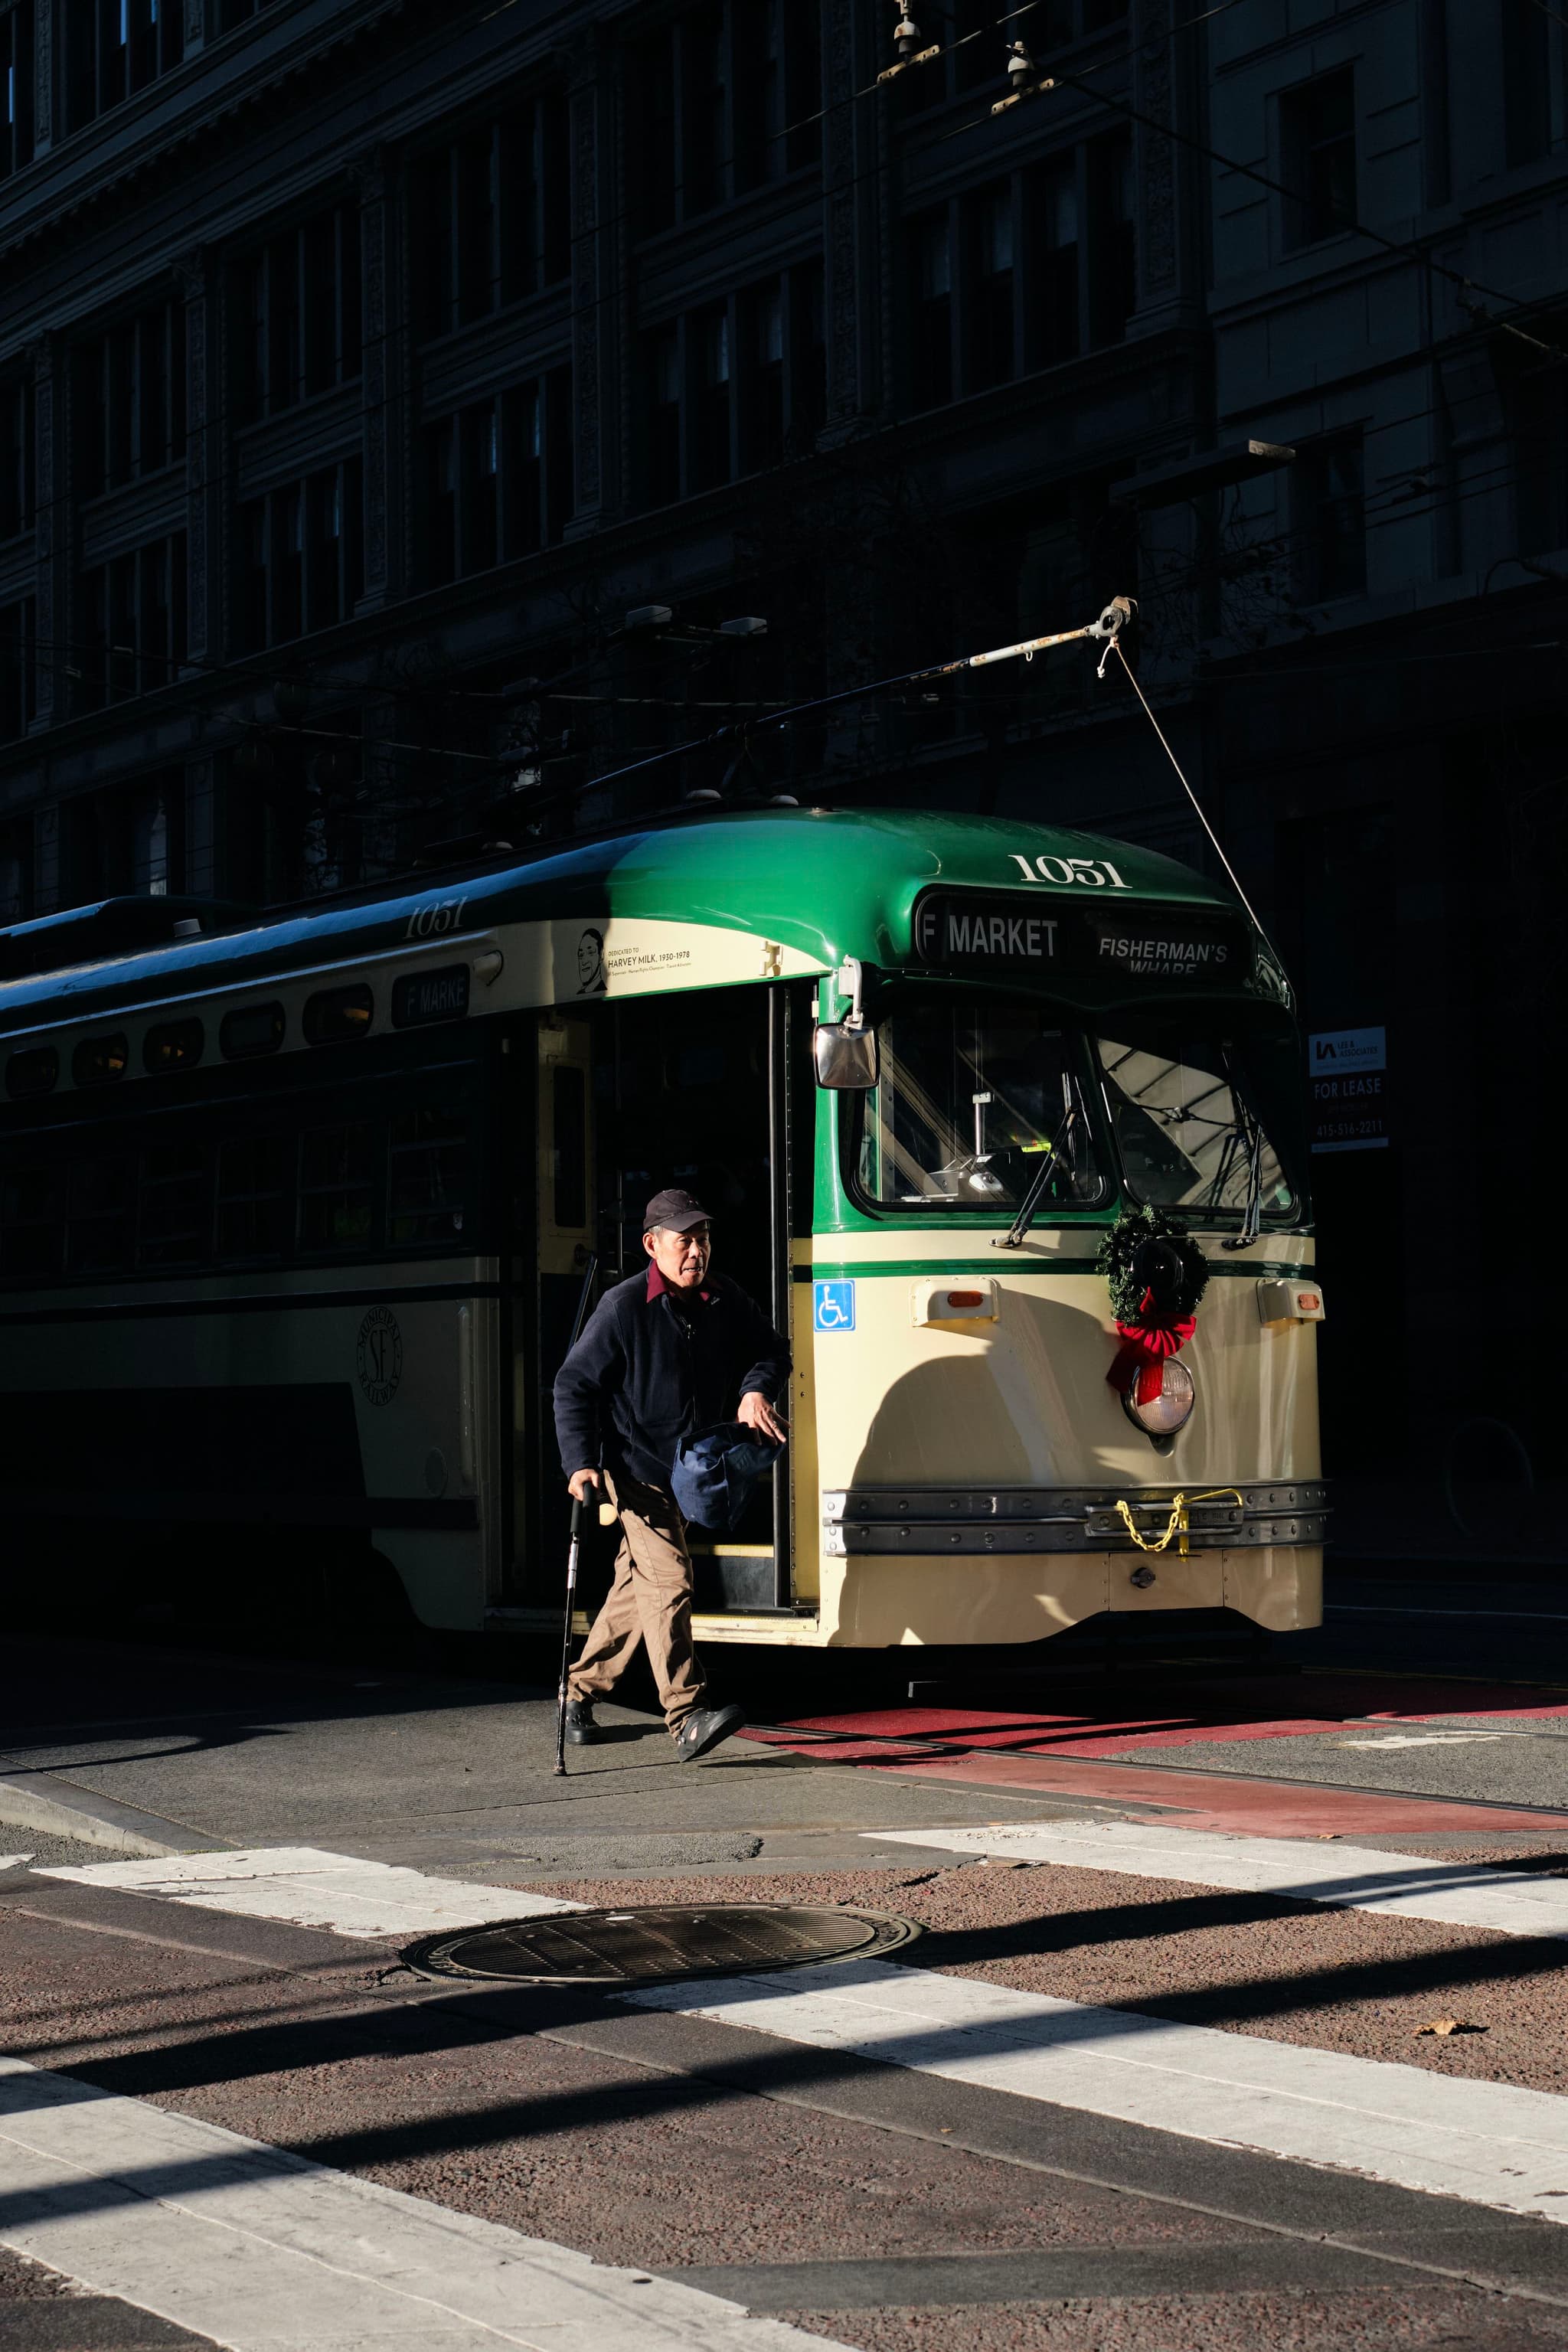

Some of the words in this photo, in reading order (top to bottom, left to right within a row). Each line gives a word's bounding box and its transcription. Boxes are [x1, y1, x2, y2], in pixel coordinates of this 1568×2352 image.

[1008, 854, 1133, 888] 1051
[401, 896, 469, 940] 1051
[923, 913, 936, 946] F
[949, 914, 1059, 957] MARKET
[608, 956, 637, 968] HARVEY
[659, 950, 691, 962] 1930-1978
[609, 948, 632, 956] DEDICATED
[1098, 937, 1229, 963] FISHERMAN'S
[1315, 1081, 1338, 1100] FOR
[1343, 1078, 1382, 1096] LEASE
